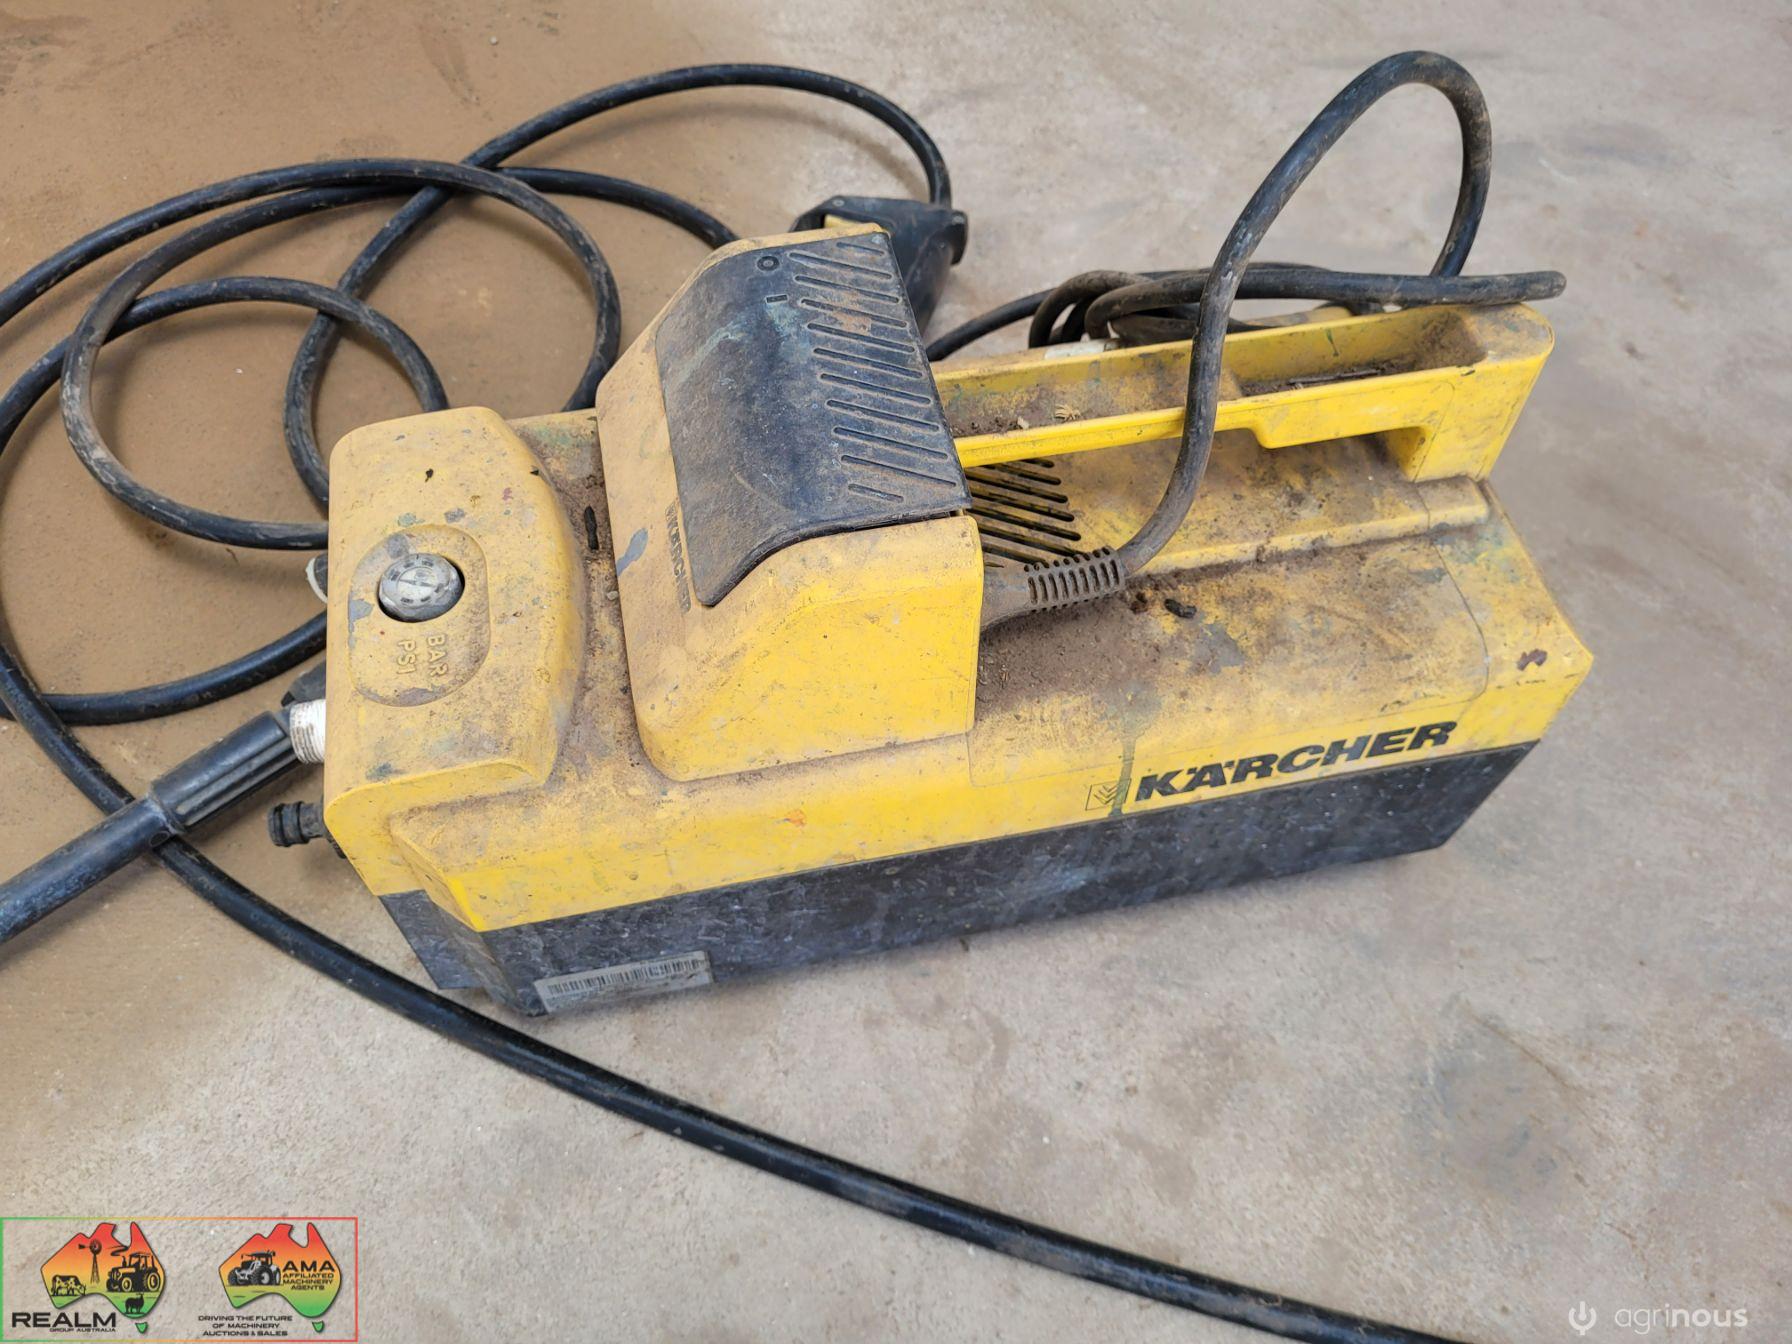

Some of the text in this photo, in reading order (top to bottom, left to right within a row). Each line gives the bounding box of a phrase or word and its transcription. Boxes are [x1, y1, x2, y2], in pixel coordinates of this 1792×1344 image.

[396, 639, 417, 675] PSI
[426, 633, 449, 677] BAR
[1135, 721, 1458, 801] KÄRCHER
